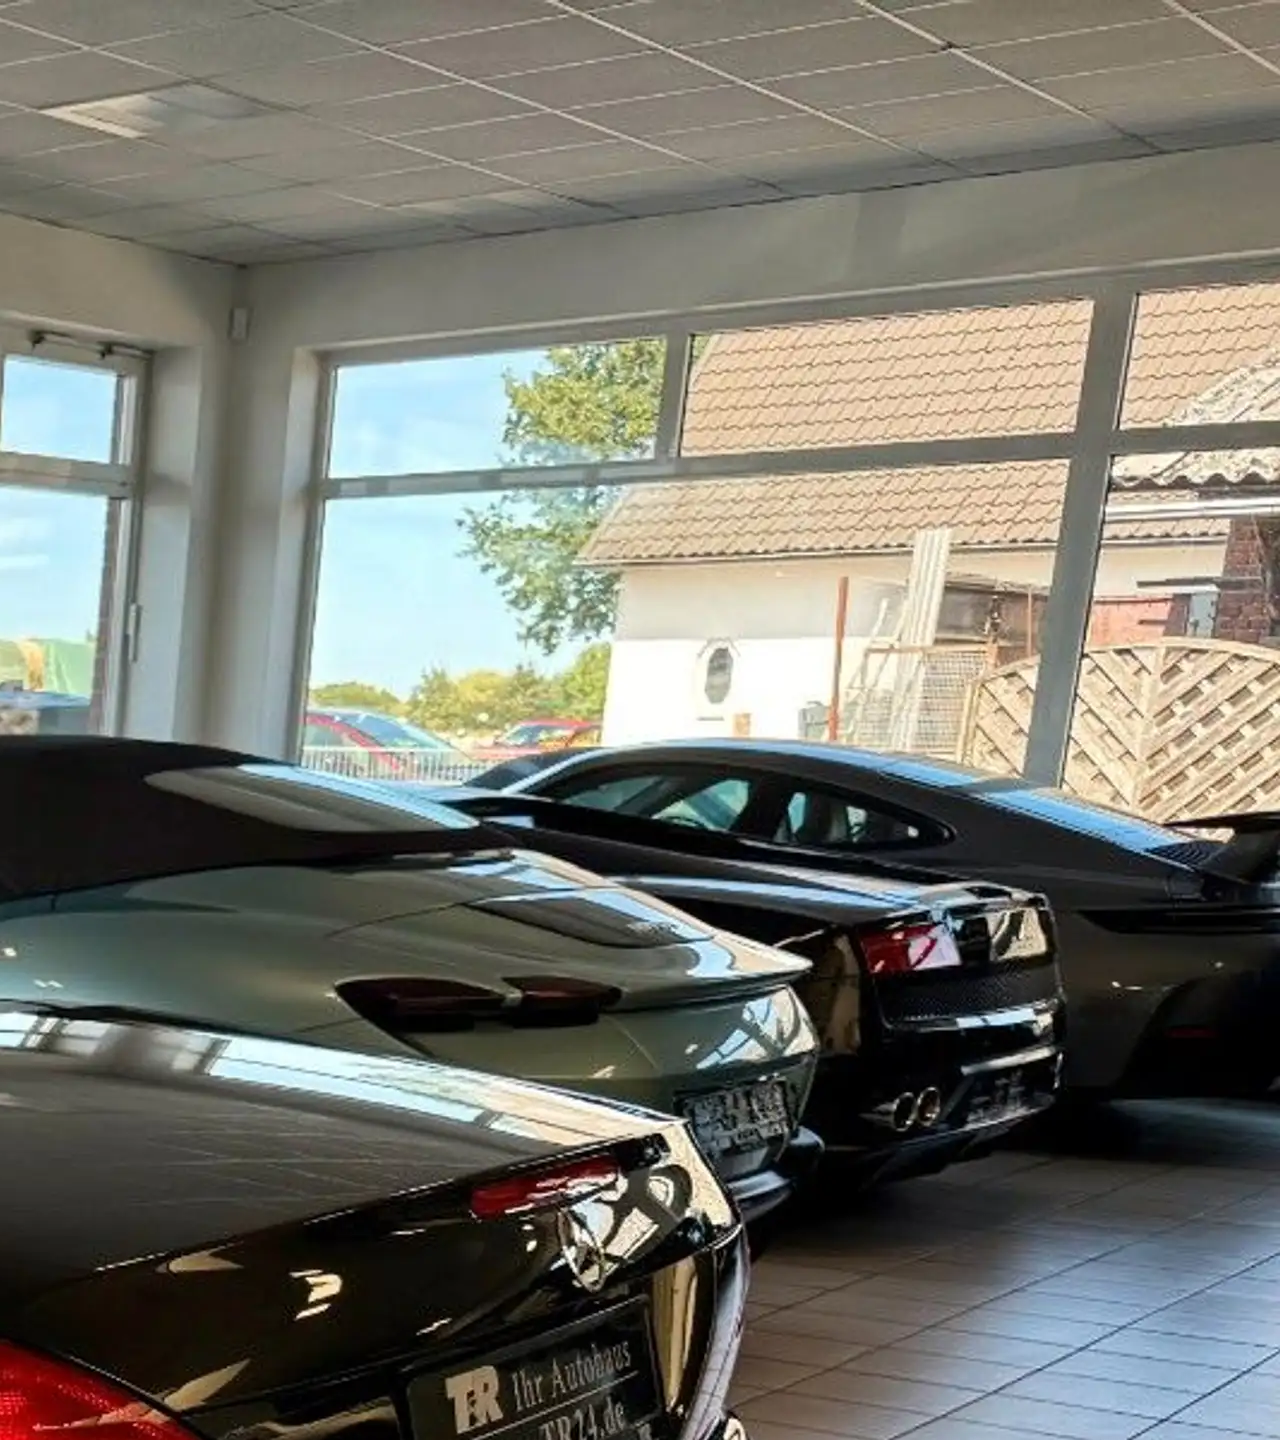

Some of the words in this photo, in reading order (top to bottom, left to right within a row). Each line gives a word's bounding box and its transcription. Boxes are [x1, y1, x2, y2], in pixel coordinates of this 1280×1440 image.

[445, 1365, 504, 1434] TR
[511, 1371, 543, 1413] Ihr
[552, 1340, 632, 1398] Autohaus
